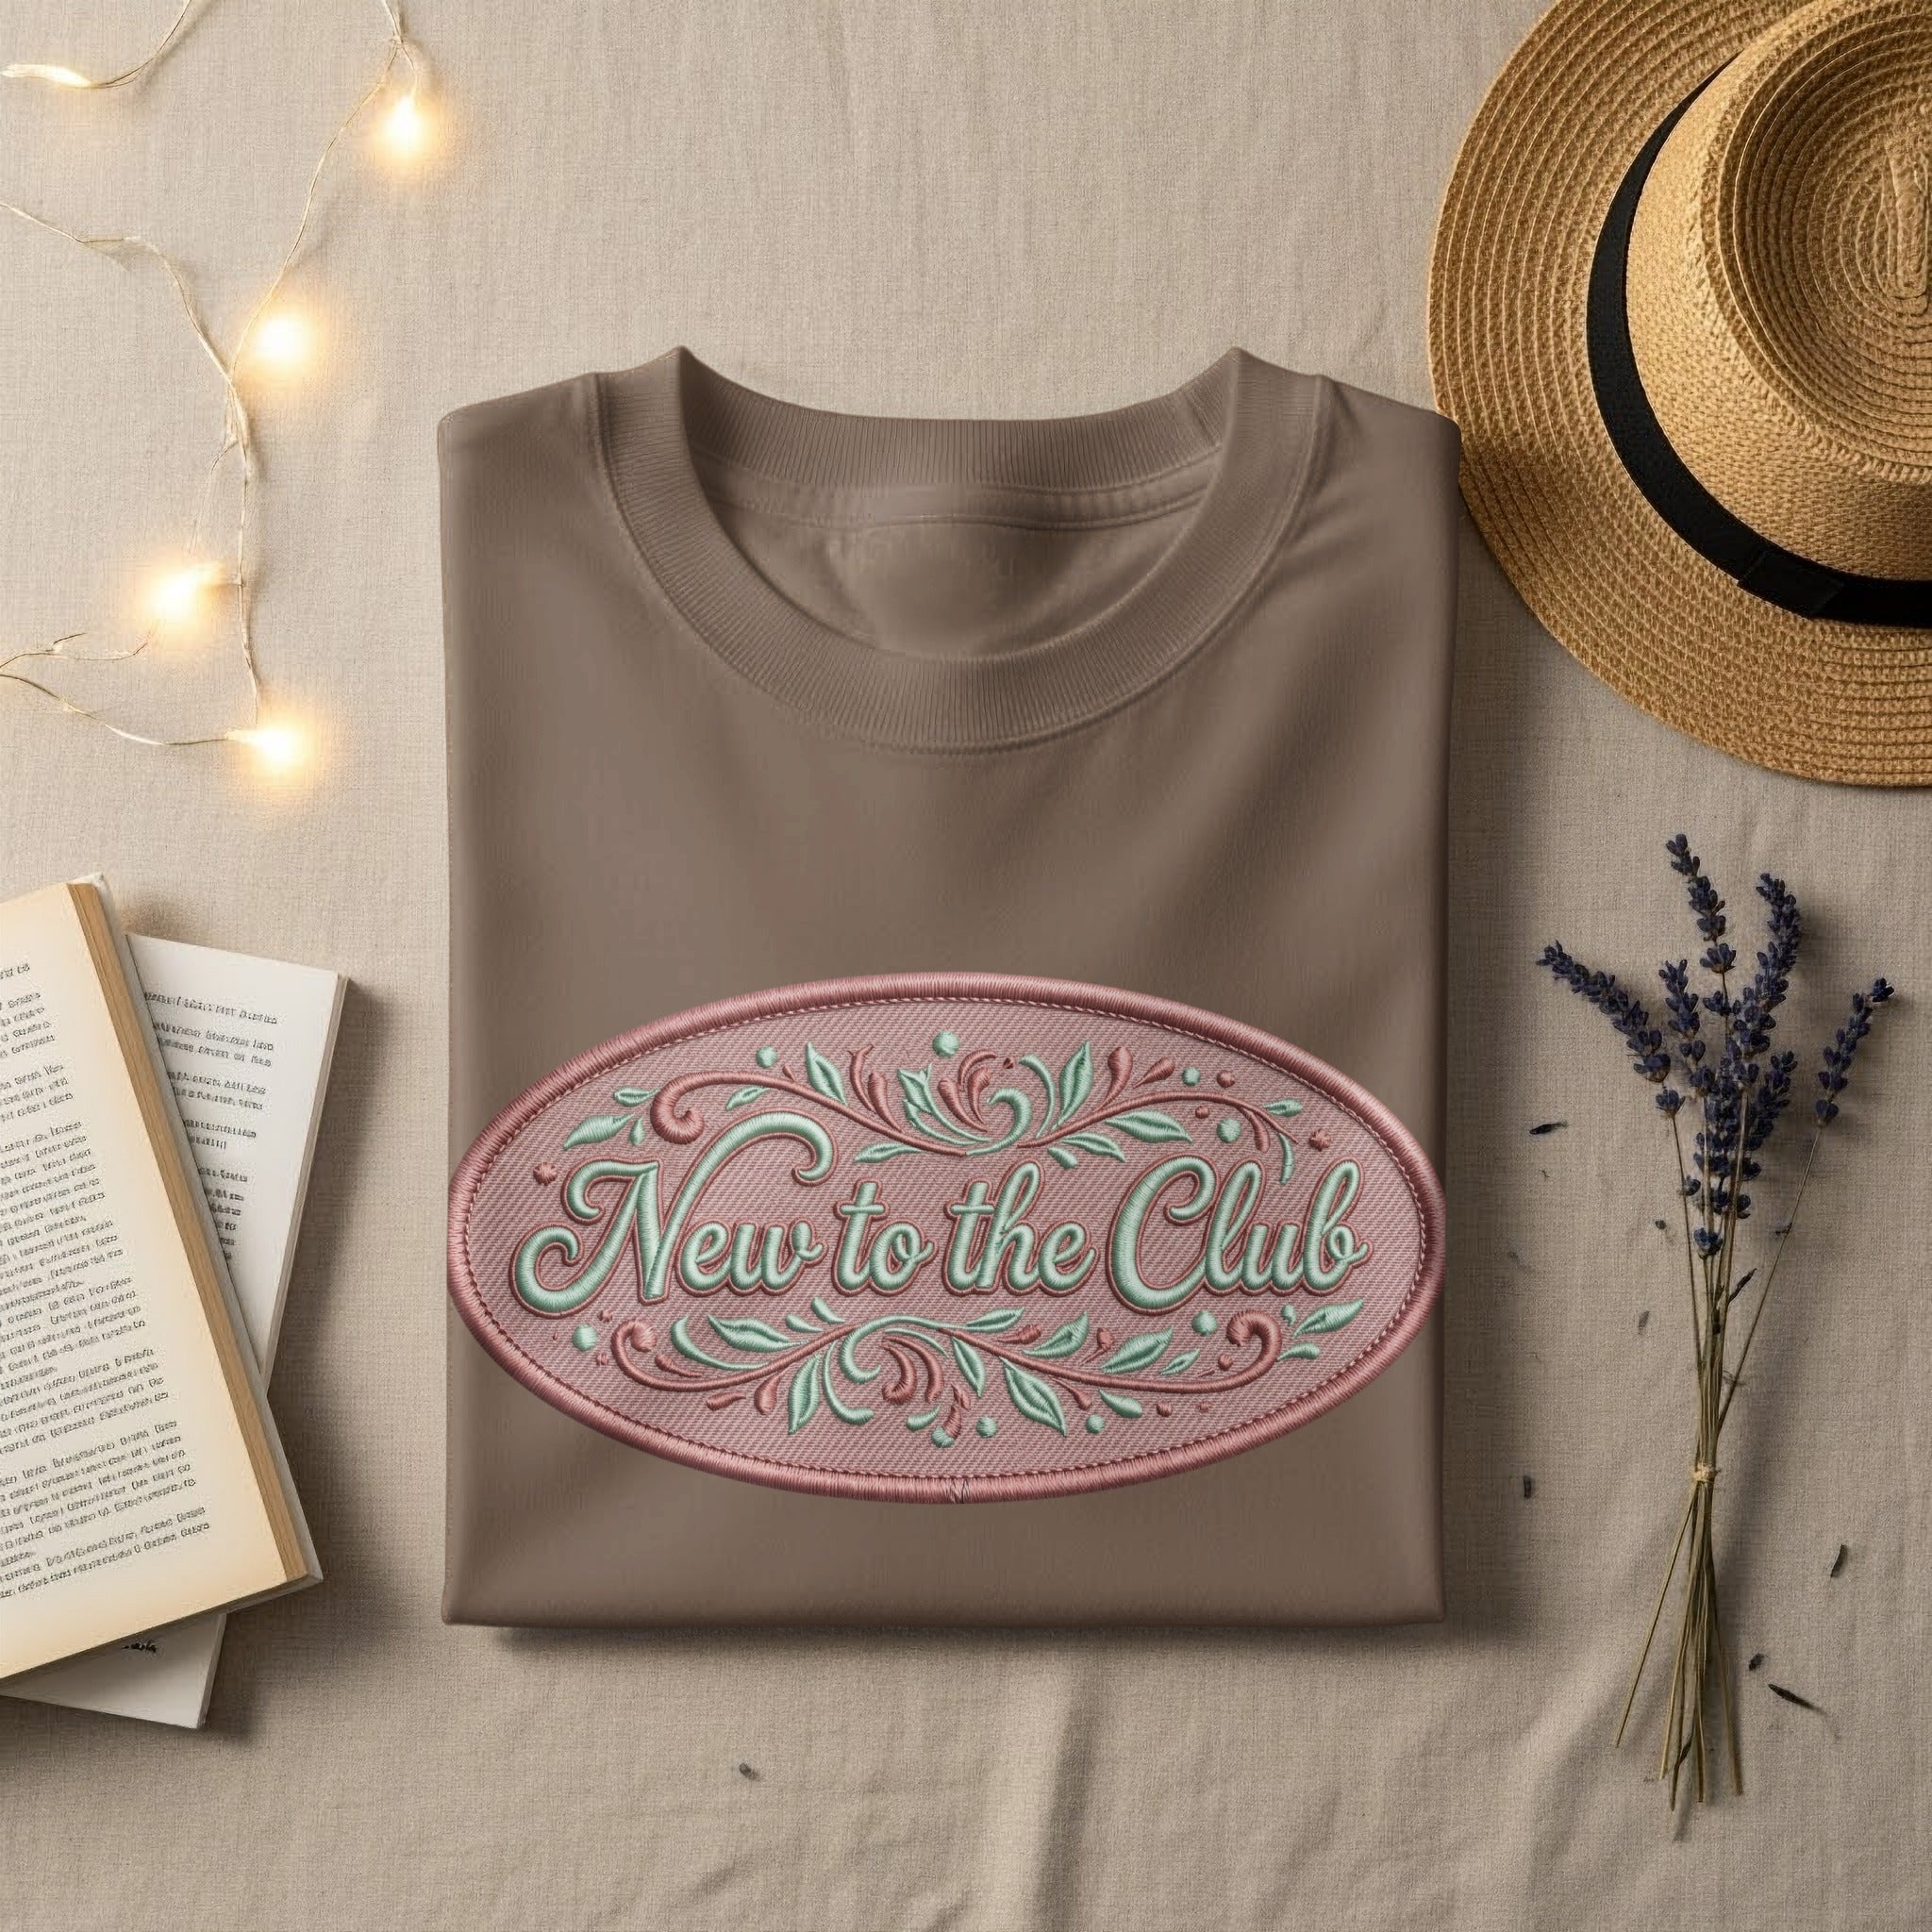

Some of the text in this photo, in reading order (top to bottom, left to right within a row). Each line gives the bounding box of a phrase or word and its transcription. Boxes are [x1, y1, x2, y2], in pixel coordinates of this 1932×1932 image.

[511, 1113, 1371, 1314] New to the Club
